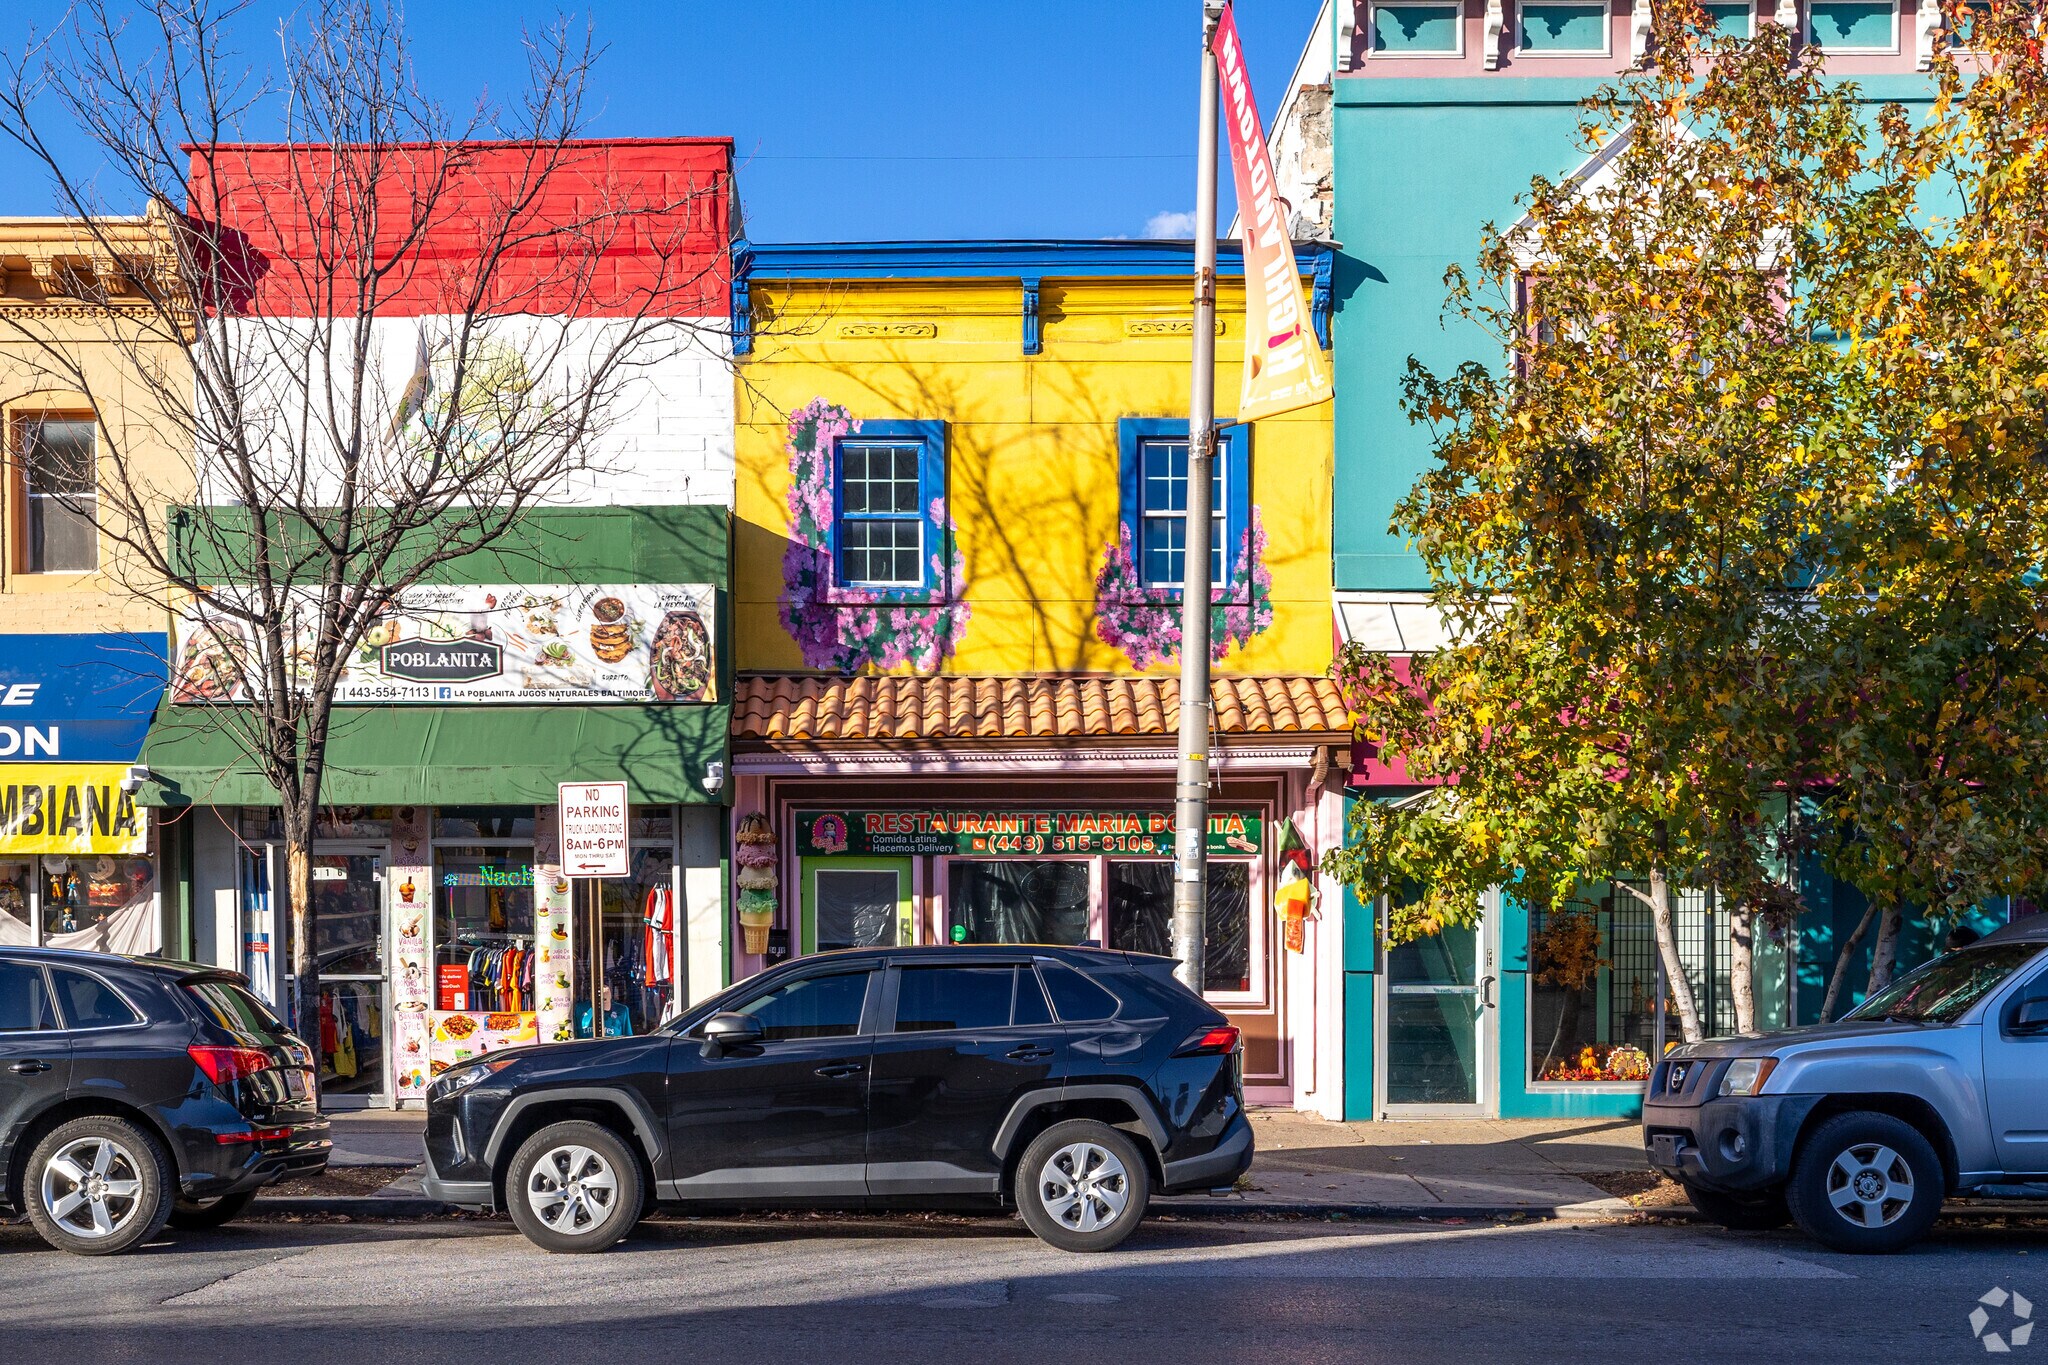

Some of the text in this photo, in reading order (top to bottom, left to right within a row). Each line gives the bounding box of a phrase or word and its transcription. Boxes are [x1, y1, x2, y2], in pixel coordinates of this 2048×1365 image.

[390, 652, 493, 668] POBLANITA
[349, 687, 430, 698] 443-554-7113
[585, 789, 600, 801] NO
[566, 805, 620, 818] PARKING
[565, 823, 623, 834] TRUCK LOADING ZONE
[865, 813, 1051, 834] RESTAURANTE
[1057, 813, 1142, 834] MARIA
[566, 838, 624, 850] 8AM-6PM
[872, 835, 937, 844] Comida Latina
[988, 835, 1154, 854] (443) 515-8105
[872, 844, 953, 853] Hacemos Delivery
